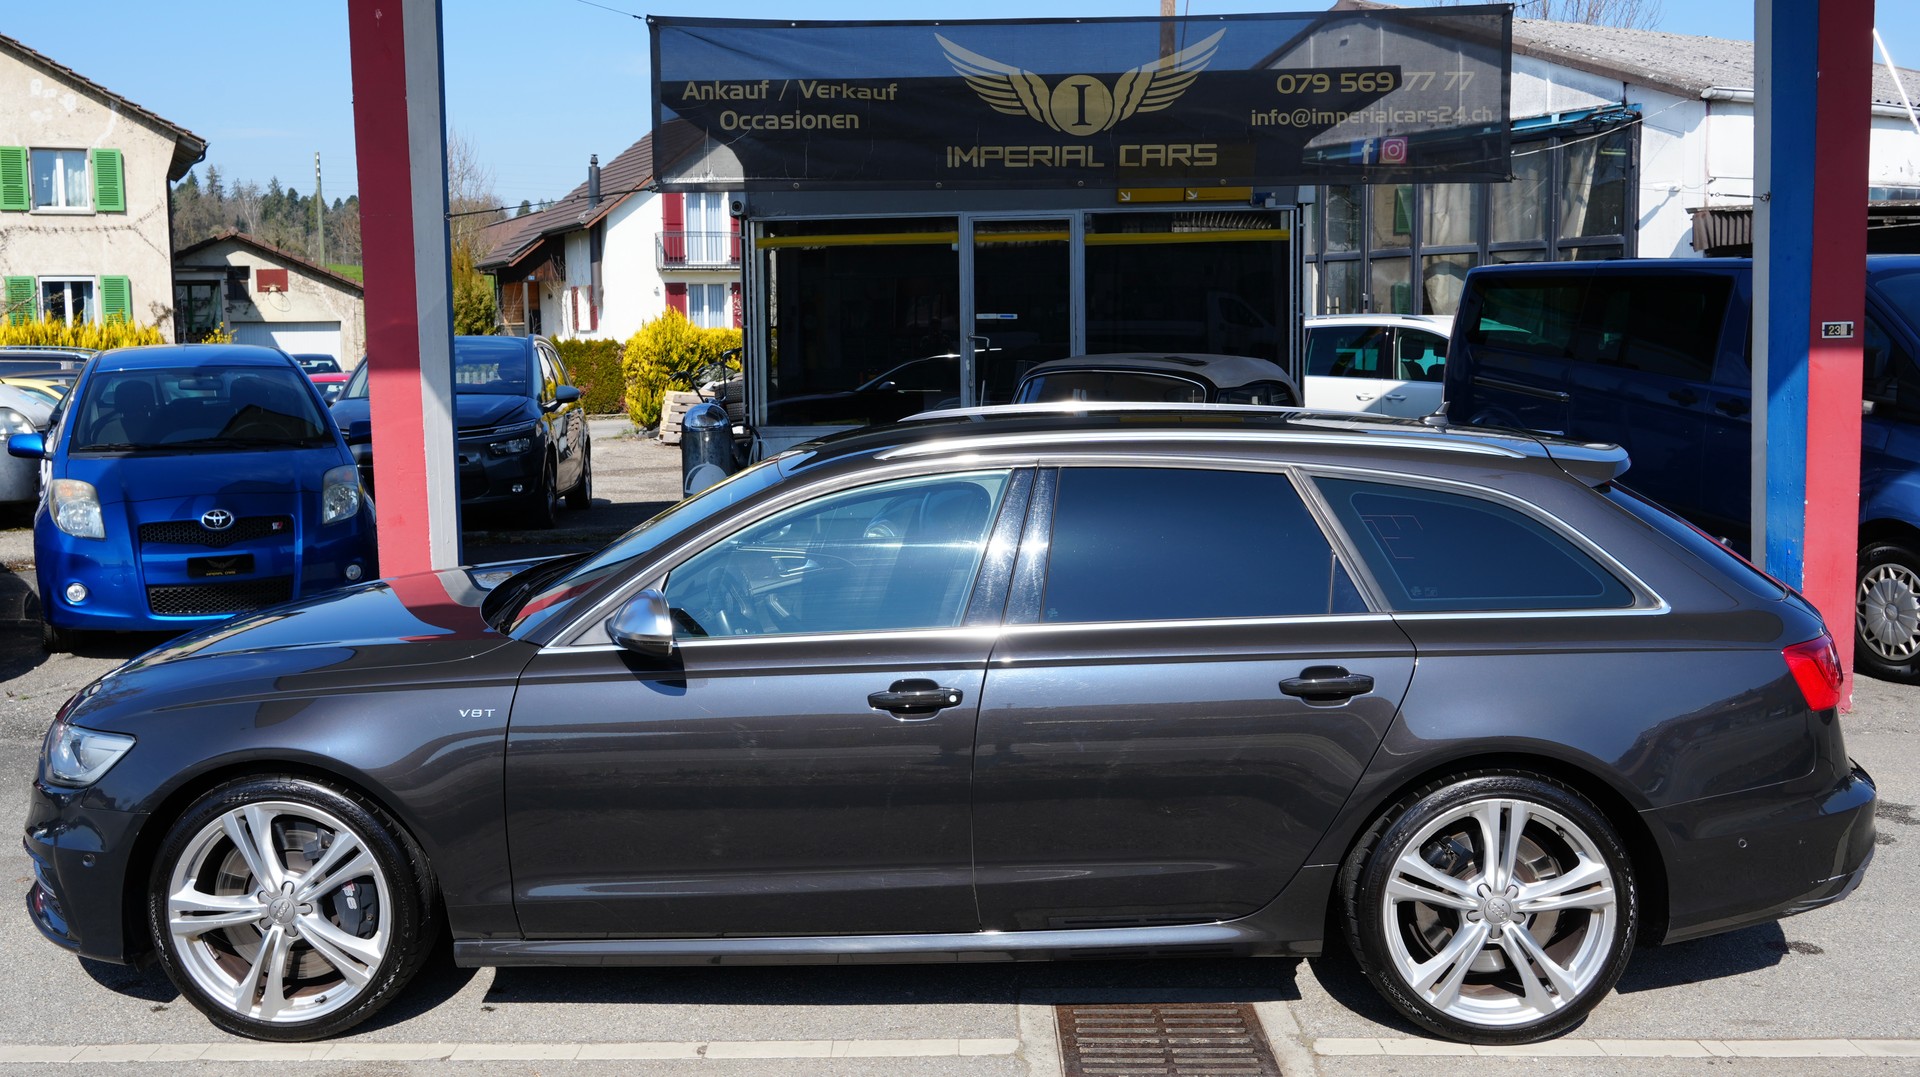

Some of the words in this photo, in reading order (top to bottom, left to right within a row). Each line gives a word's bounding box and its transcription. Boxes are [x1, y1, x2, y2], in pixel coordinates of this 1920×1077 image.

[681, 80, 770, 100] Ankauf
[778, 79, 790, 101] /
[798, 80, 898, 100] Verkauf
[1276, 73, 1331, 94] 079
[1340, 72, 1394, 93] 569
[1403, 71, 1436, 92] 77
[1444, 71, 1475, 91] 77
[719, 109, 860, 131] Occasionen
[1251, 105, 1493, 128] info@imperialcars24.ch
[946, 145, 1105, 168] IMPERIAL
[1119, 143, 1218, 167] CARS
[1828, 325, 1841, 335] 23
[458, 708, 496, 718] V8T
